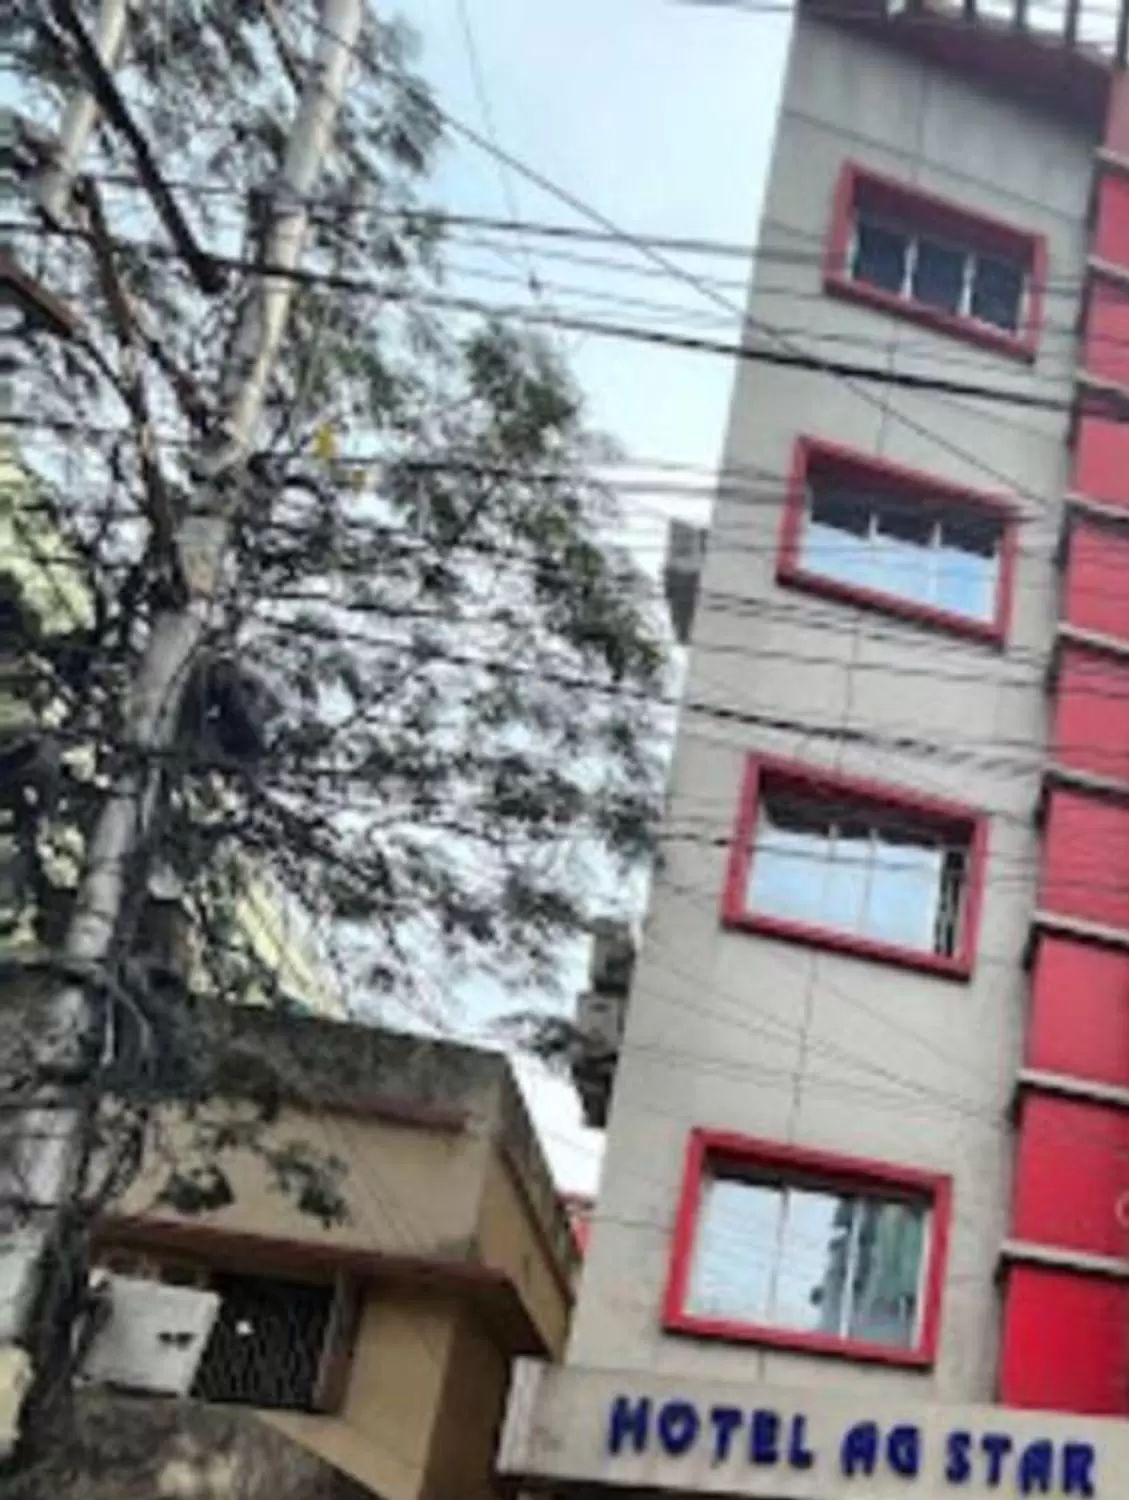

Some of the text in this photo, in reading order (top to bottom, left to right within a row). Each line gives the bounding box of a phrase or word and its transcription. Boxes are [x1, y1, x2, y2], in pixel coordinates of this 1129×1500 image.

[607, 1396, 1096, 1499] HOTEL AG STAR
